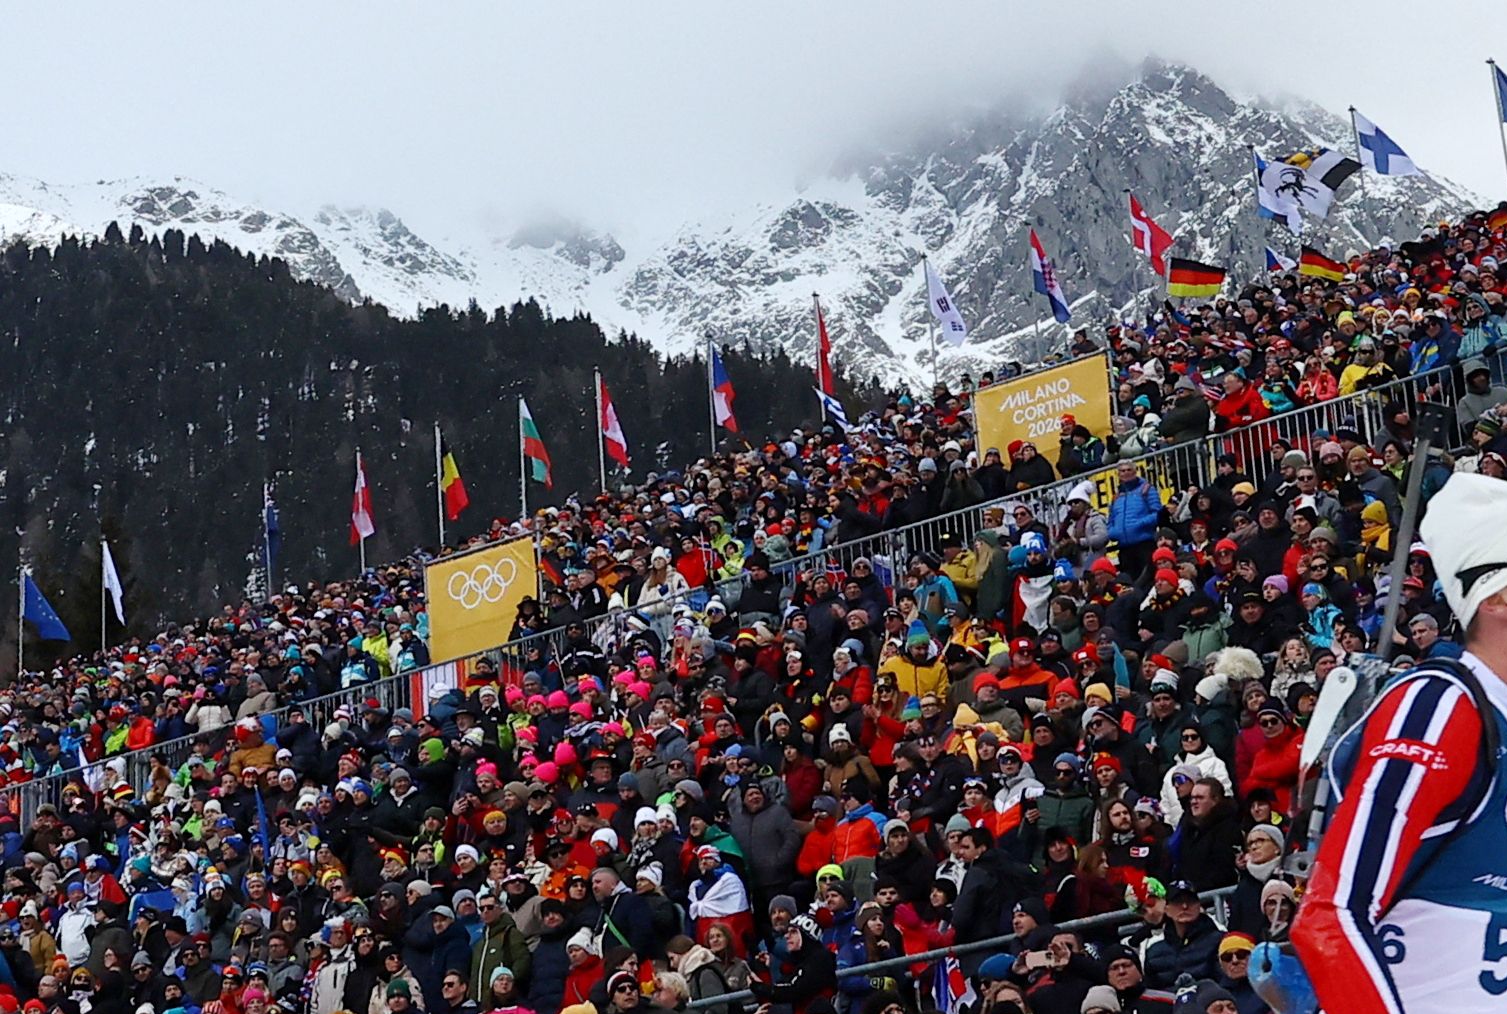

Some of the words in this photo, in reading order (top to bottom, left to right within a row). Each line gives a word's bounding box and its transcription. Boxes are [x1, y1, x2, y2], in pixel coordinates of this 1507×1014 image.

[1000, 378, 1071, 412] MILANO
[1012, 393, 1087, 425] CORTINA
[1027, 416, 1063, 439] 2026
[1368, 741, 1435, 763] CRAFT
